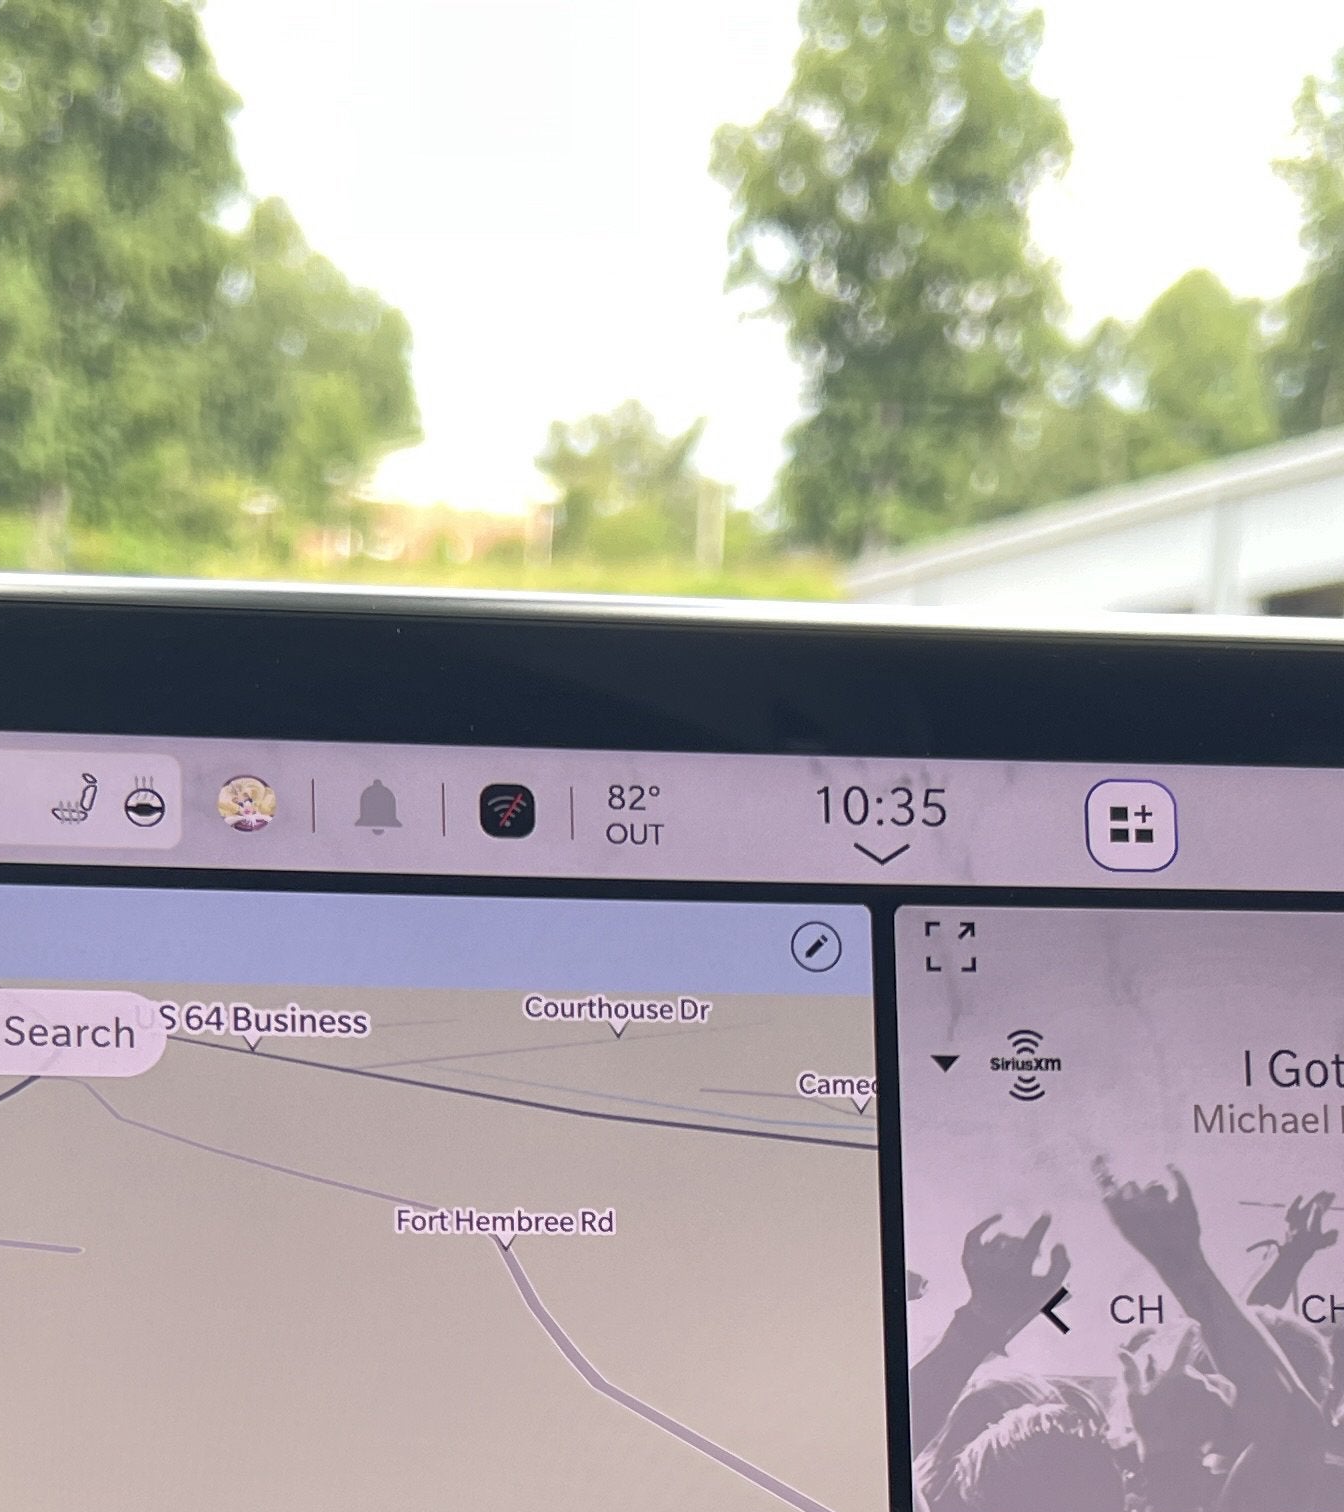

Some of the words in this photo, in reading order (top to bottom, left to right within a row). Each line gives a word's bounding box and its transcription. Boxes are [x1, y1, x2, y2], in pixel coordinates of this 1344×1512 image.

[608, 784, 661, 811] 82°
[816, 785, 947, 828] 10:35
[606, 822, 664, 846] OUT
[185, 1005, 224, 1031] 64
[233, 1006, 368, 1034] Business
[525, 996, 673, 1021] Courthouse
[681, 998, 710, 1021] Dr
[4, 1015, 135, 1049] Search
[1244, 1050, 1252, 1087] I
[1193, 1103, 1329, 1134] Michael
[397, 1209, 448, 1232] Fort
[455, 1209, 574, 1232] Hembree
[581, 1211, 614, 1232] Rd
[1109, 1294, 1164, 1325] CH
